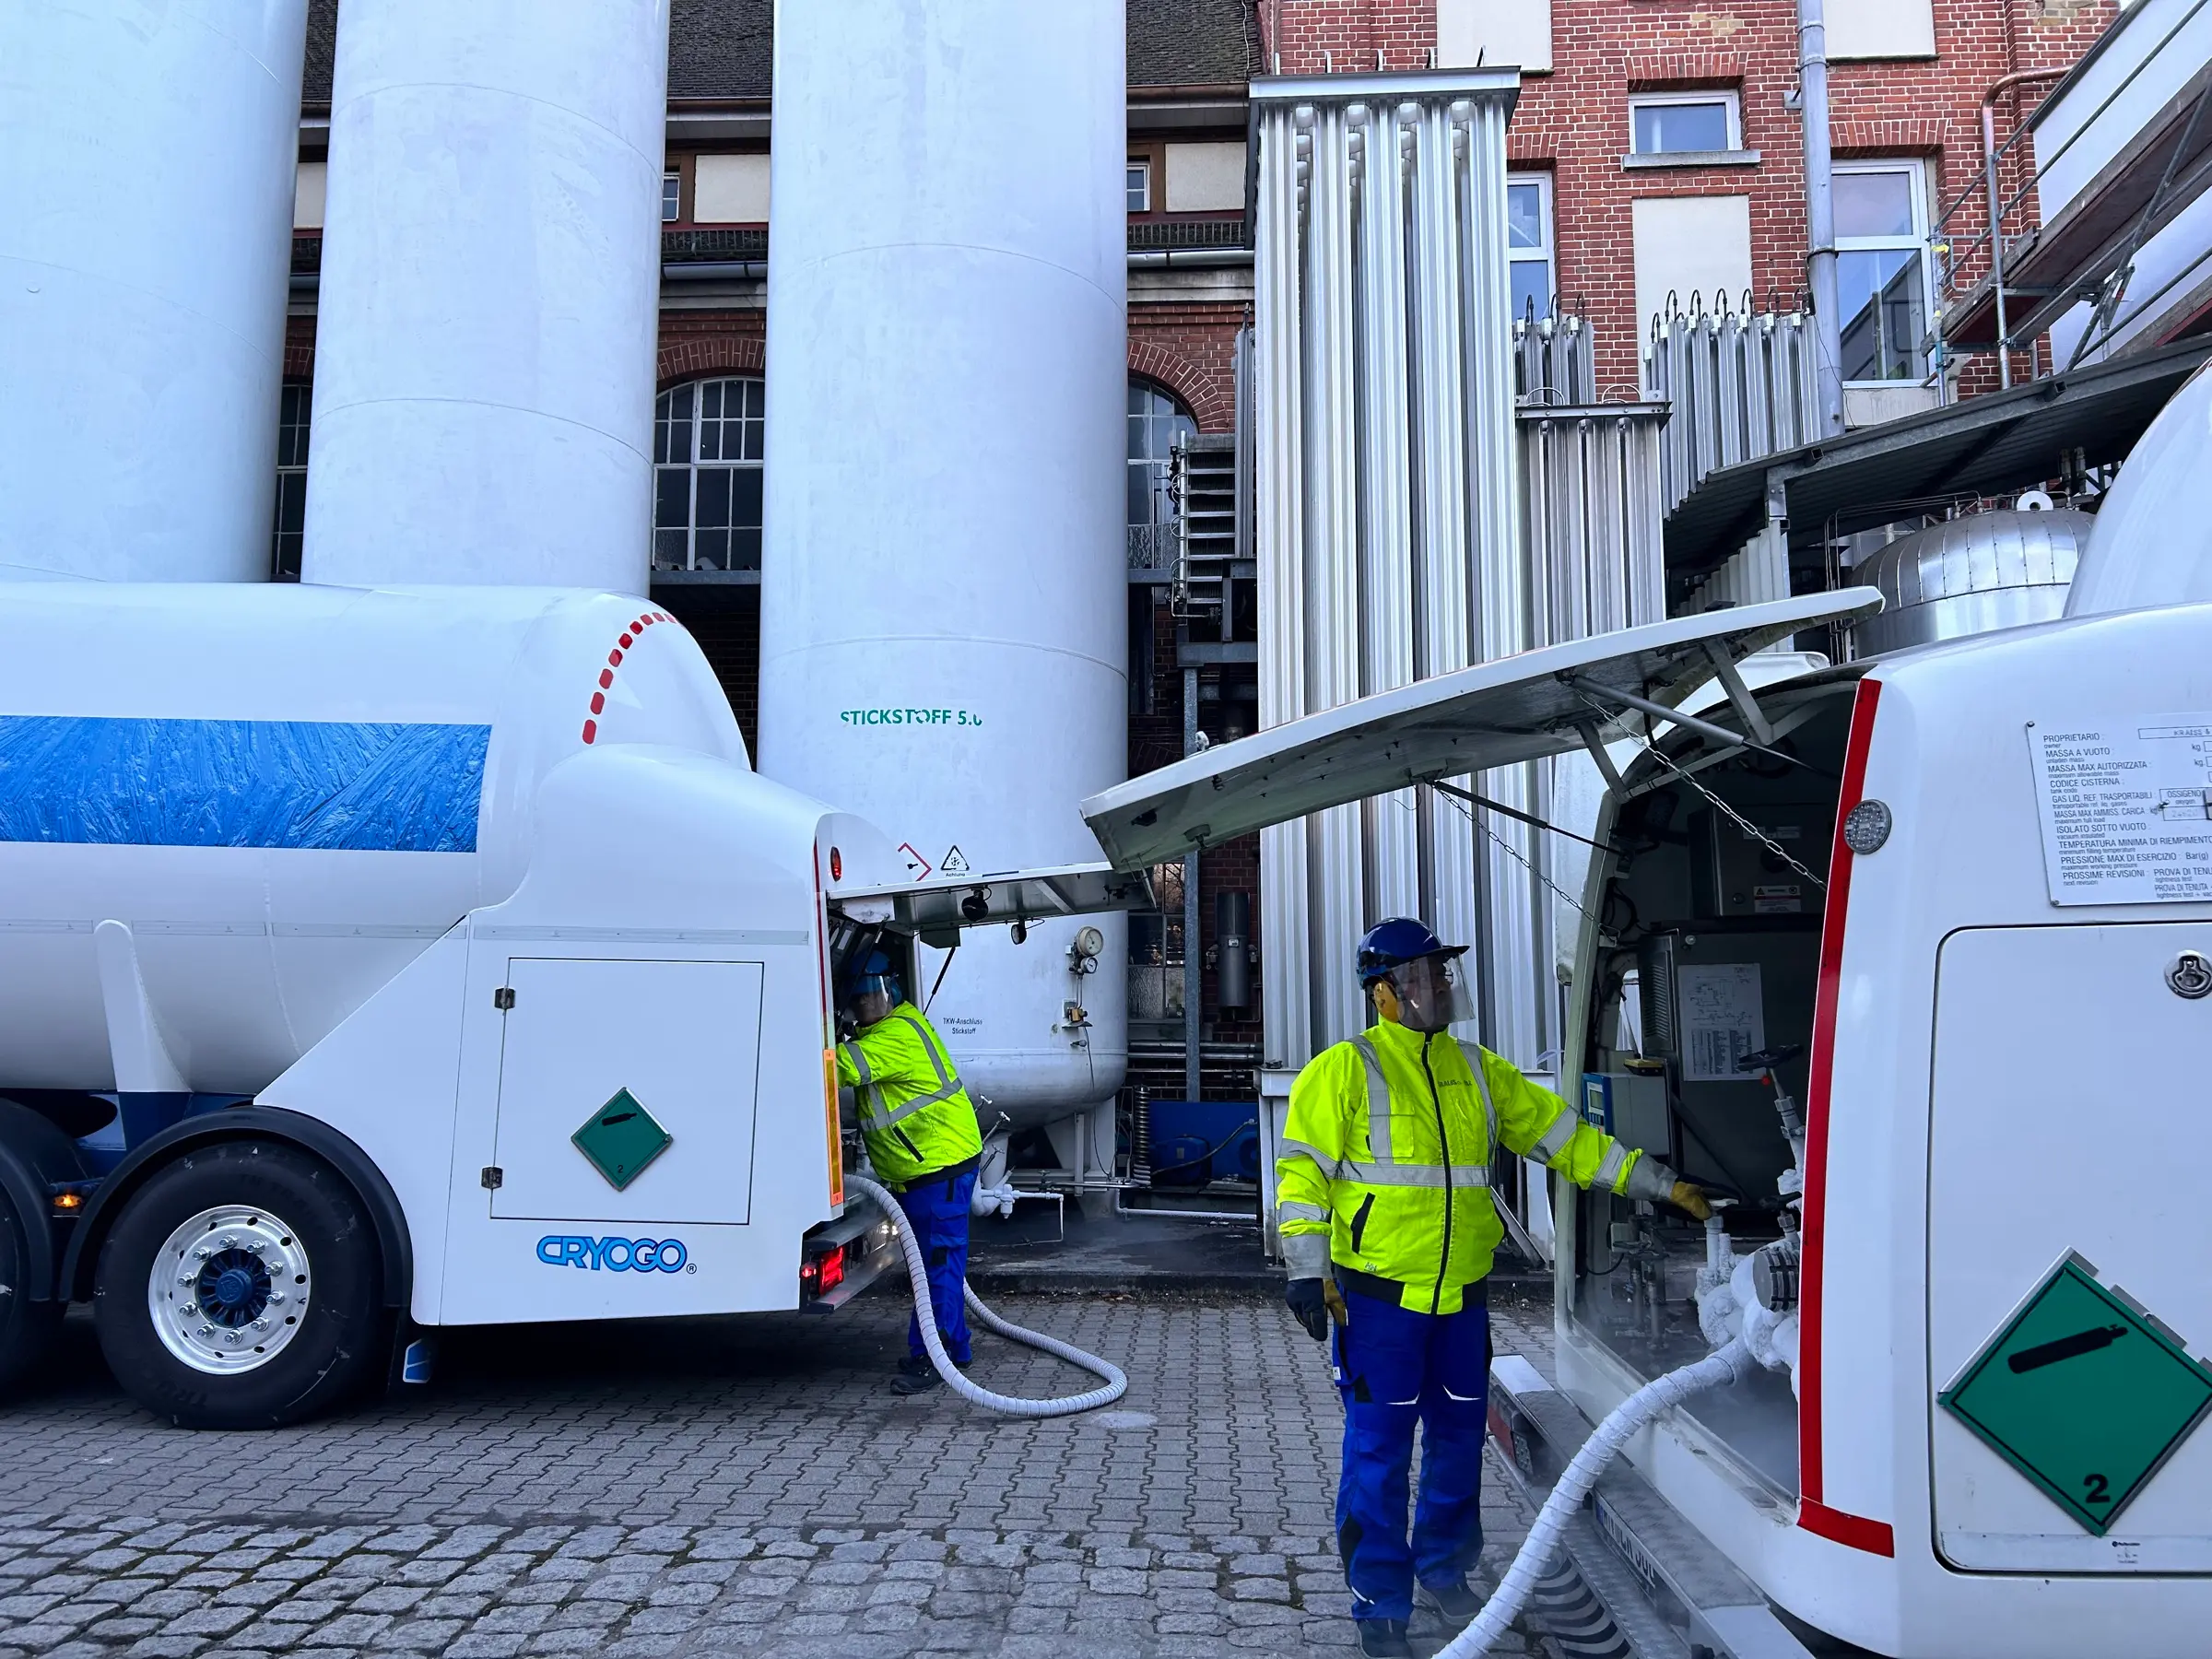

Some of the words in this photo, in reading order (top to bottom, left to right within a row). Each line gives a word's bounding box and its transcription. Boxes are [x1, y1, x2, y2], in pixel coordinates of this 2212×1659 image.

[841, 709, 951, 725] STICKSTOFF
[2043, 733, 2100, 742] PROPRIETARIO
[2083, 747, 2111, 756] VUOTO
[2048, 764, 2076, 772] MASSA
[2097, 761, 2147, 771] AUTORIZZATA
[2050, 779, 2079, 788] CODICE
[2081, 778, 2120, 786] CISTERNA
[2053, 794, 2066, 803] GAS
[2100, 791, 2152, 801] TRASPORTABILI
[2167, 789, 2202, 797] OSSIGENO
[2054, 809, 2077, 818] MASSA
[2122, 806, 2145, 816] CARICA
[2056, 824, 2089, 833] ISOLATO
[2091, 824, 2117, 832] SOTTO
[2120, 822, 2147, 830] VUOTO
[2059, 840, 2116, 849] TEMPERATURA
[2118, 838, 2148, 847] MINIMA
[2149, 837, 2158, 845] DI
[2061, 855, 2105, 865] PRESSIONE
[2107, 854, 2124, 863] MAX
[2136, 853, 2176, 862] ESERCIZIO
[2063, 870, 2104, 880] PROSSIME
[2106, 869, 2145, 878] REVISIONI
[2154, 867, 2181, 876] PROVA
[2183, 867, 2191, 876] DI
[617, 1164, 624, 1173] 2
[2083, 1474, 2111, 1503] 2
